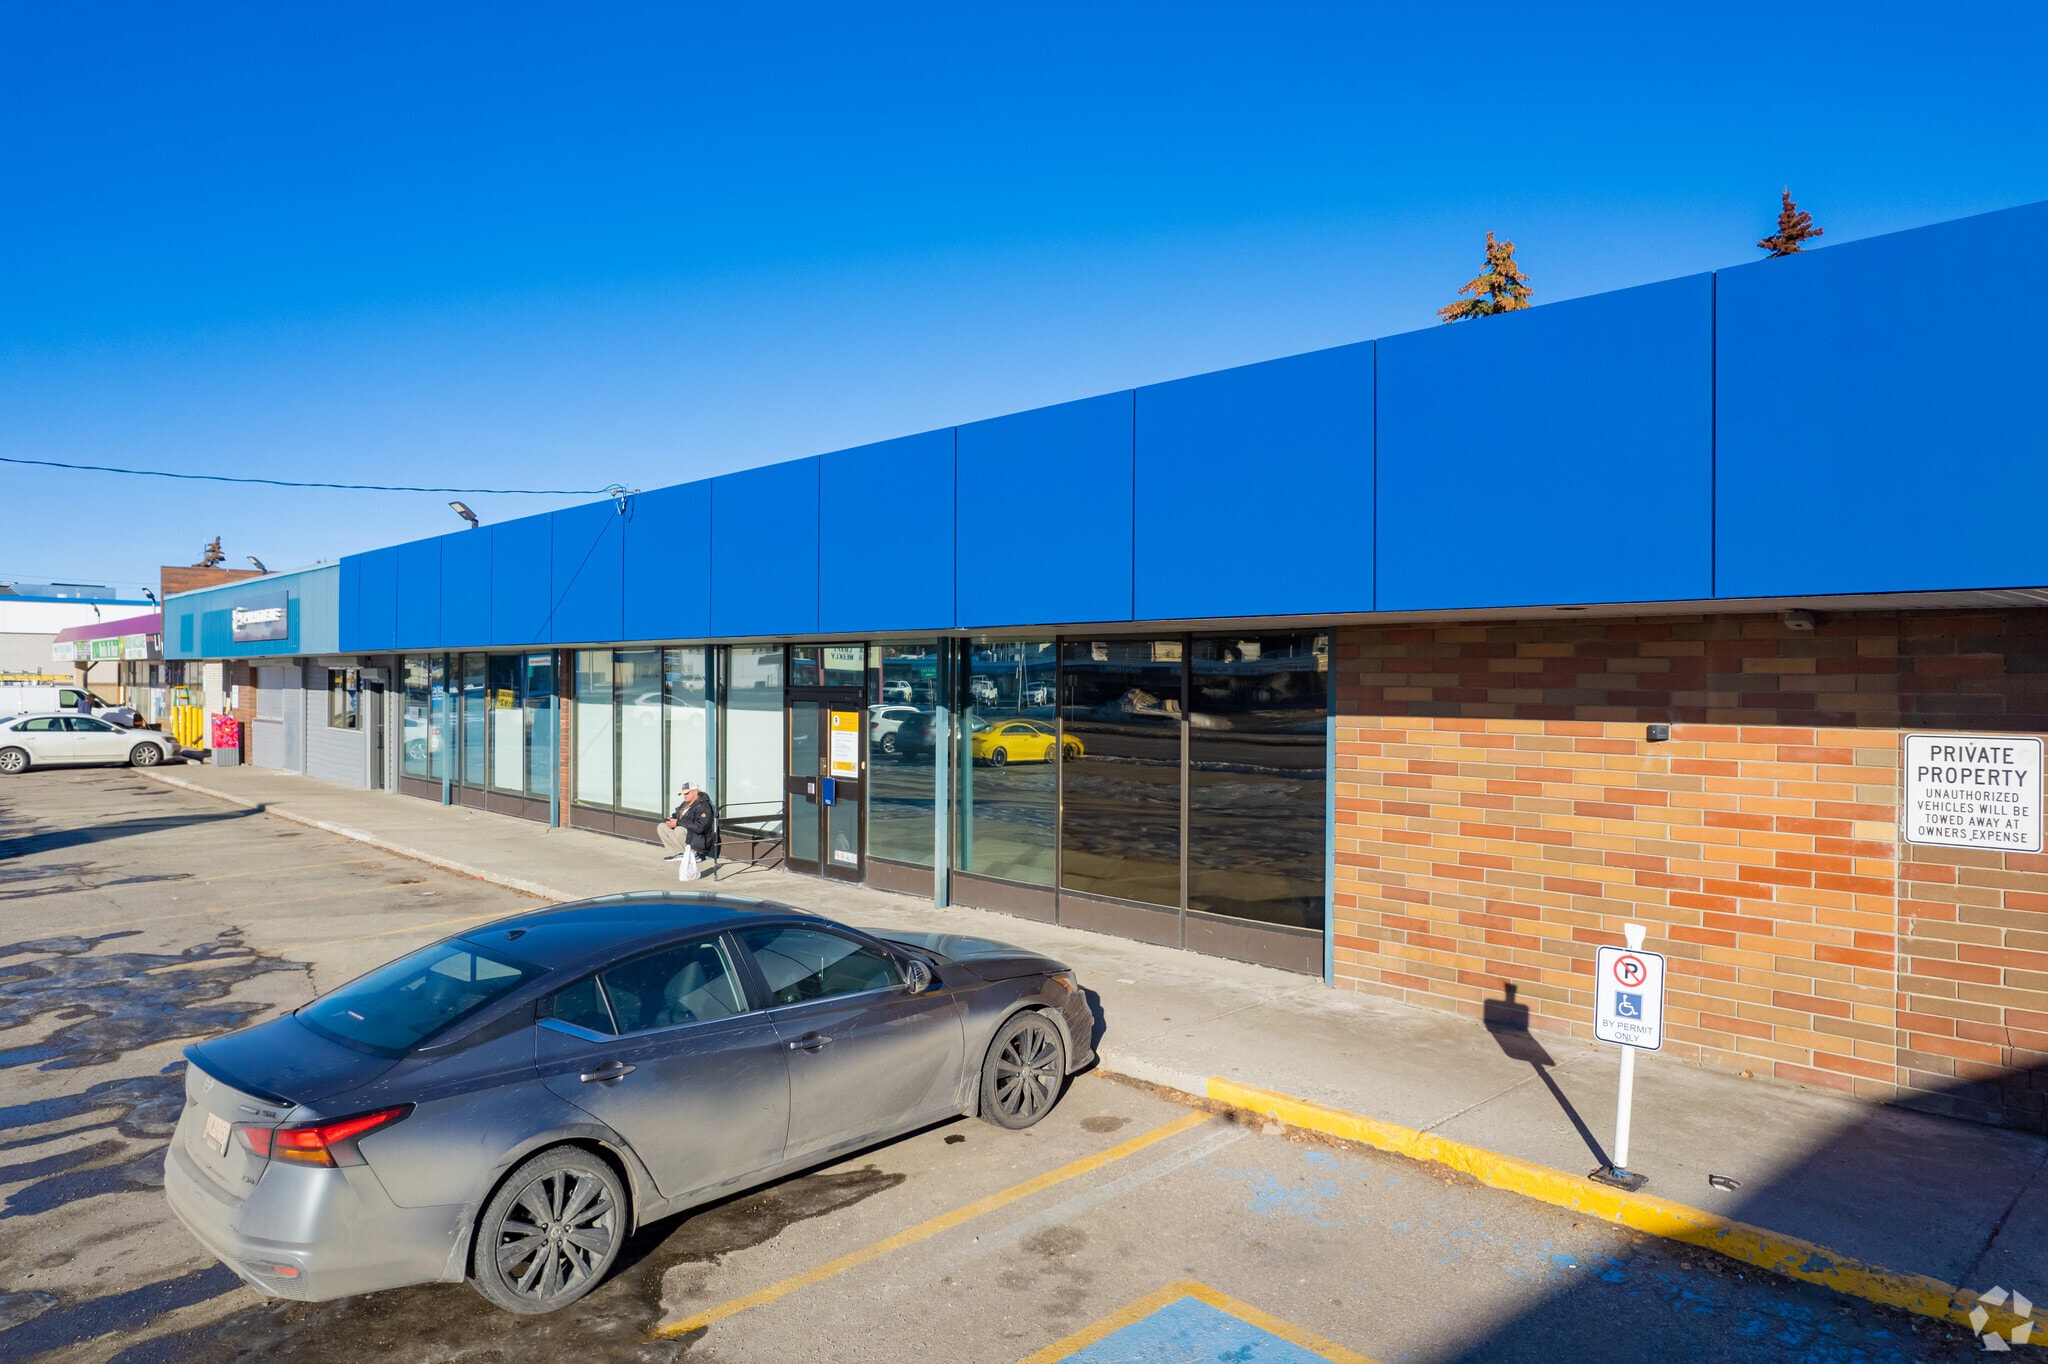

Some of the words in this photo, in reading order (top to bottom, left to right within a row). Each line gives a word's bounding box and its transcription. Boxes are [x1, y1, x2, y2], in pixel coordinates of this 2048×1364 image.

[1931, 745, 2014, 764] PRIVATE
[1918, 766, 2027, 787] PROPERTY
[1926, 788, 2019, 803] UNAUTHORIZED
[1917, 801, 1974, 813] VEHICLES
[1979, 804, 2007, 815] WILL
[2013, 806, 2029, 816] BE
[1925, 814, 1963, 825] TOWED
[1969, 817, 2000, 828] AWAY
[2005, 819, 2019, 829] AT
[1918, 826, 1967, 838] OWNERS
[1972, 830, 2027, 843] EXPENSE
[1602, 1020, 1615, 1028] BY
[1617, 1022, 1653, 1035] PERMIT
[1615, 1032, 1640, 1042] ONLY
